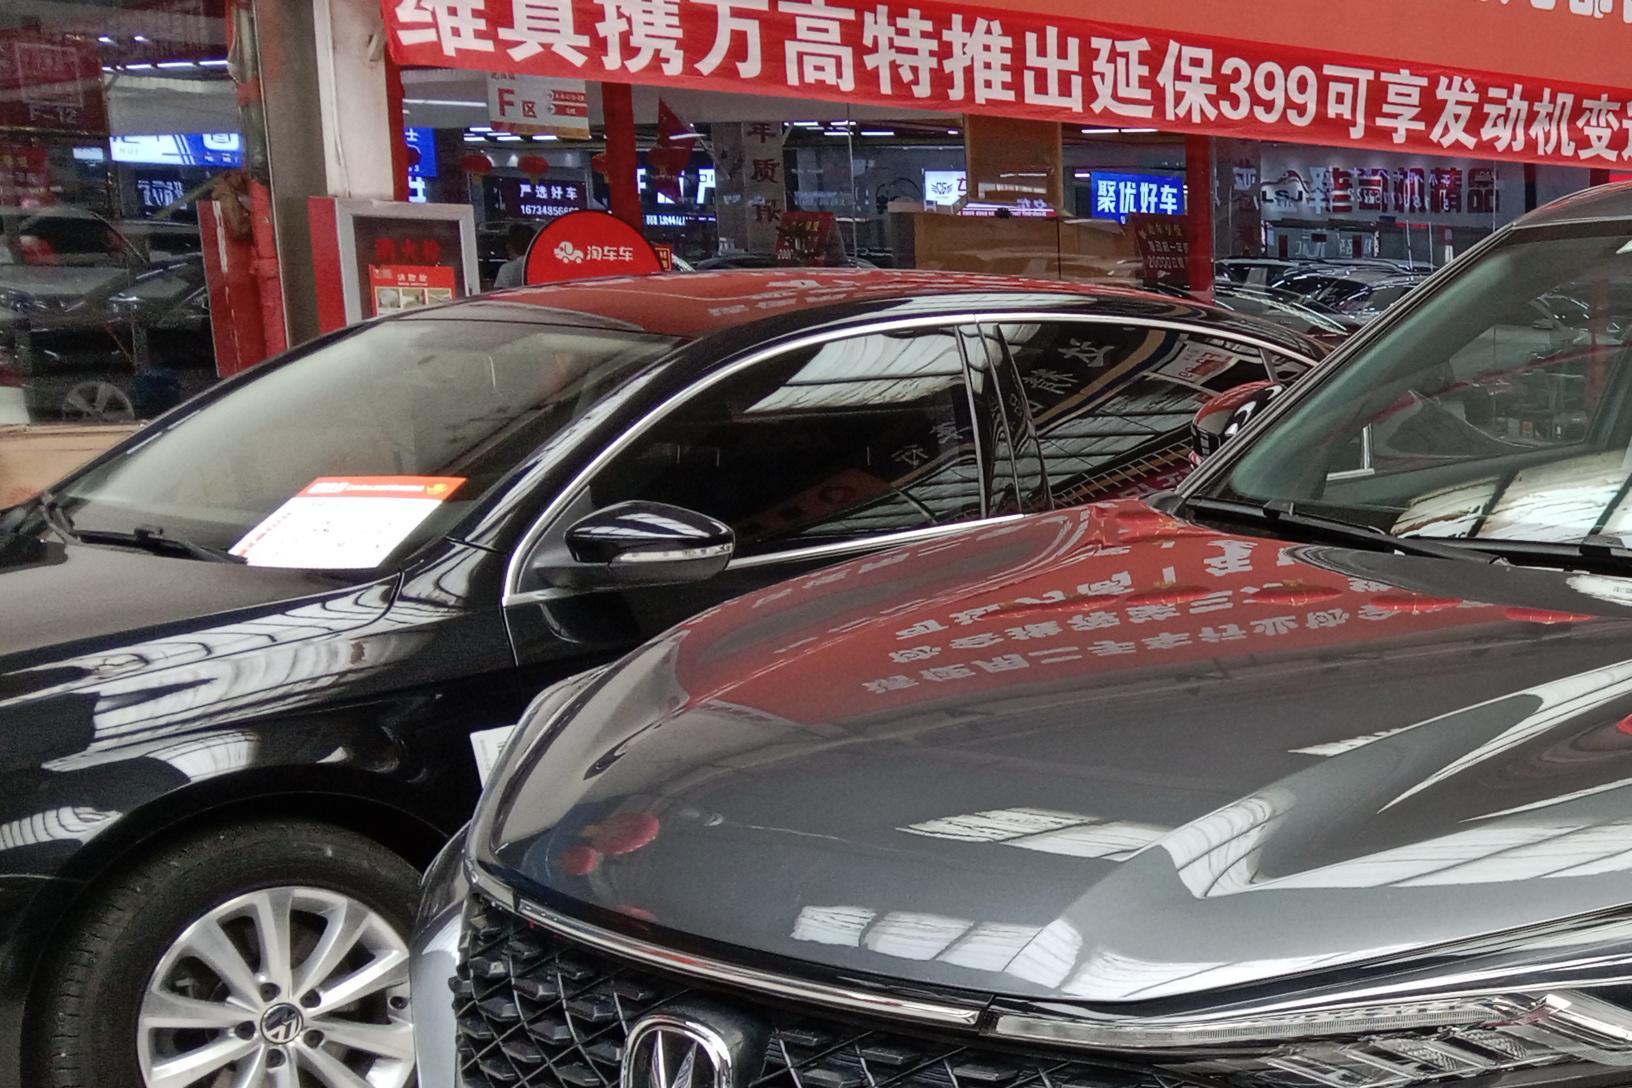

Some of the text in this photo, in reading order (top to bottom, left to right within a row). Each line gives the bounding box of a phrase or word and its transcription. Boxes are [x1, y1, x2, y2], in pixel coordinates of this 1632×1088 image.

[520, 184, 578, 200] 严选好车
[1097, 180, 1178, 215] 聚优好车
[586, 246, 634, 262] 淘车车
